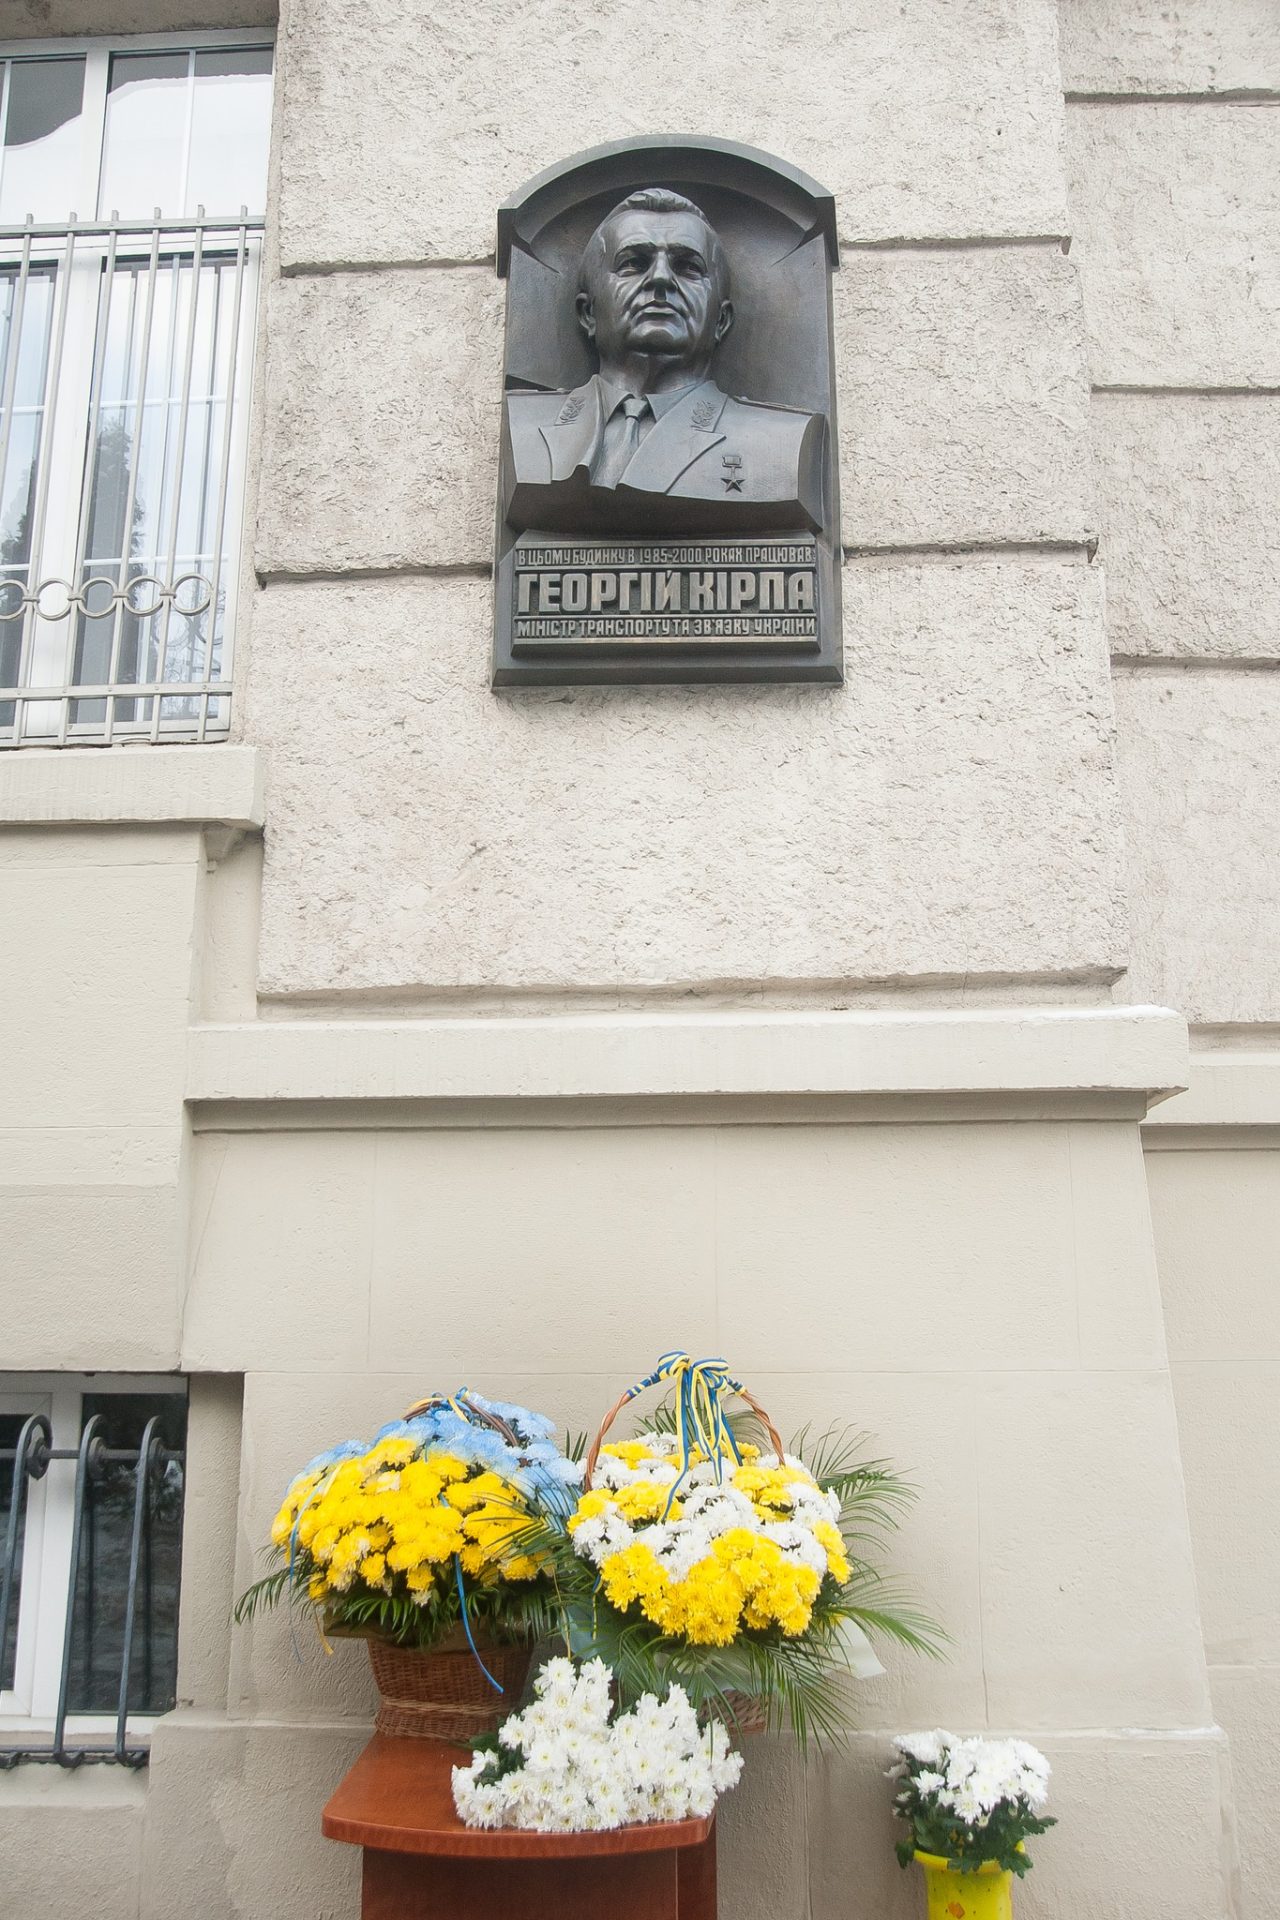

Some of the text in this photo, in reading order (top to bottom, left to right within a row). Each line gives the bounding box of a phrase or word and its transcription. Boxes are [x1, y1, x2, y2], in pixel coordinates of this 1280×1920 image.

[518, 546, 812, 566] В ЦЬОМУ БУДИНКУ В 1985-2000 РОКАХ ПРАЦЮВАВ
[518, 570, 814, 612] ГЕОРГІЙ КІРПА
[517, 620, 576, 637] МІНІСТР
[579, 619, 670, 636] ТРАНСПОРТУ
[673, 618, 690, 635] ТА
